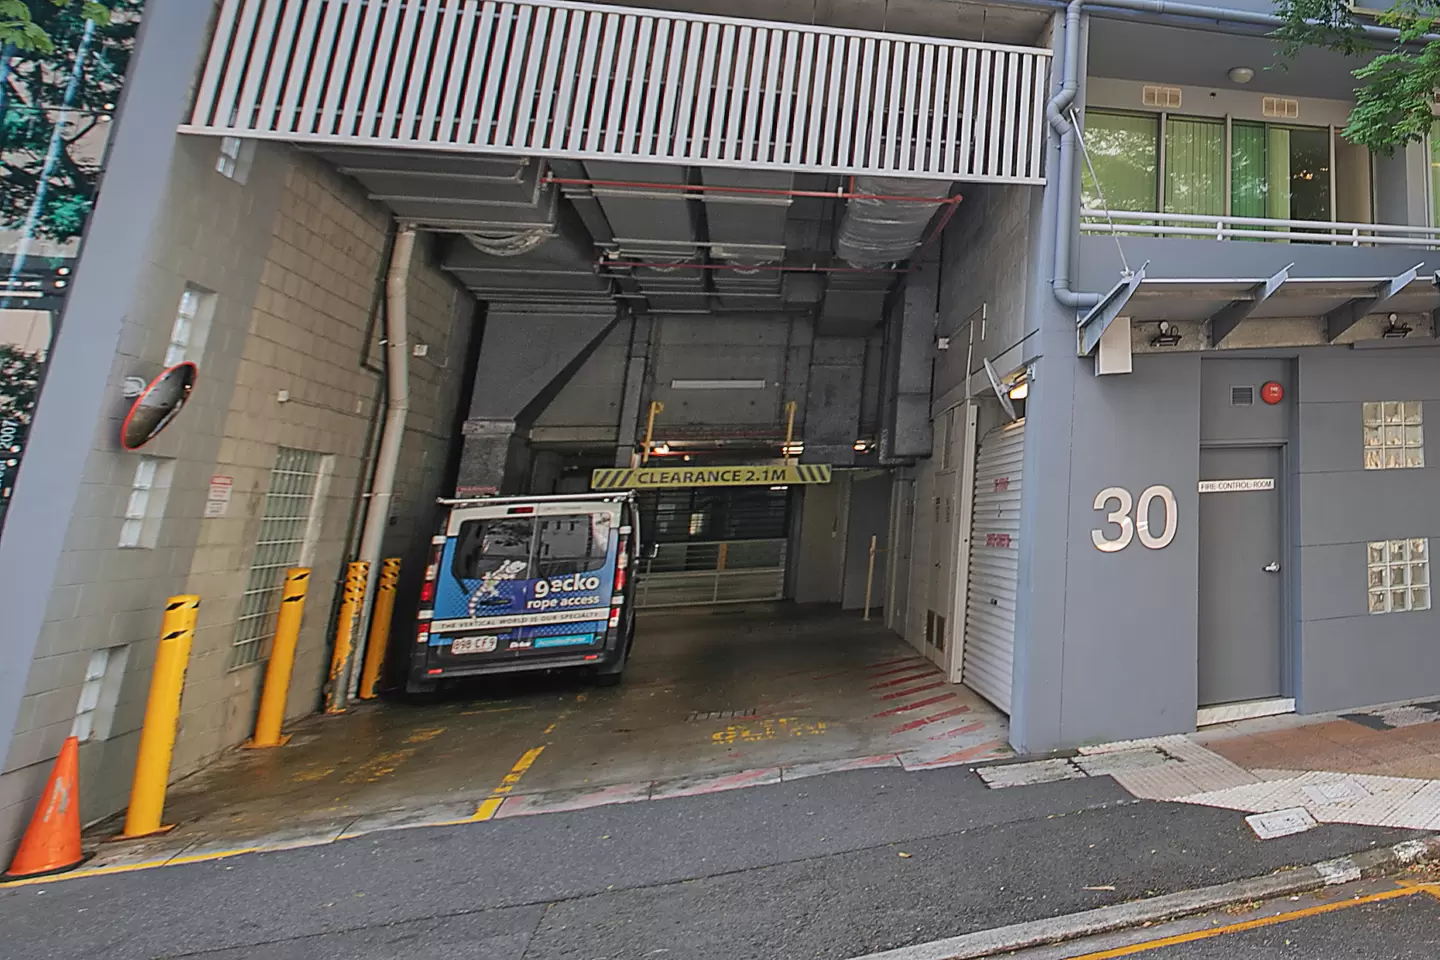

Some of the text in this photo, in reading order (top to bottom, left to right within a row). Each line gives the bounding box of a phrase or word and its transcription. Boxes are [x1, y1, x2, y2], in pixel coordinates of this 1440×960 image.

[637, 469, 786, 484] CLEARANCE 2.1M
[1218, 481, 1251, 489] CONTROL
[1090, 484, 1179, 553] 30
[535, 574, 600, 599] gecko
[527, 595, 600, 611] rope access
[459, 620, 497, 628] VERTICAL
[560, 612, 599, 620] SPECIALTY
[454, 639, 471, 650] 898
[475, 637, 496, 649] CF9
